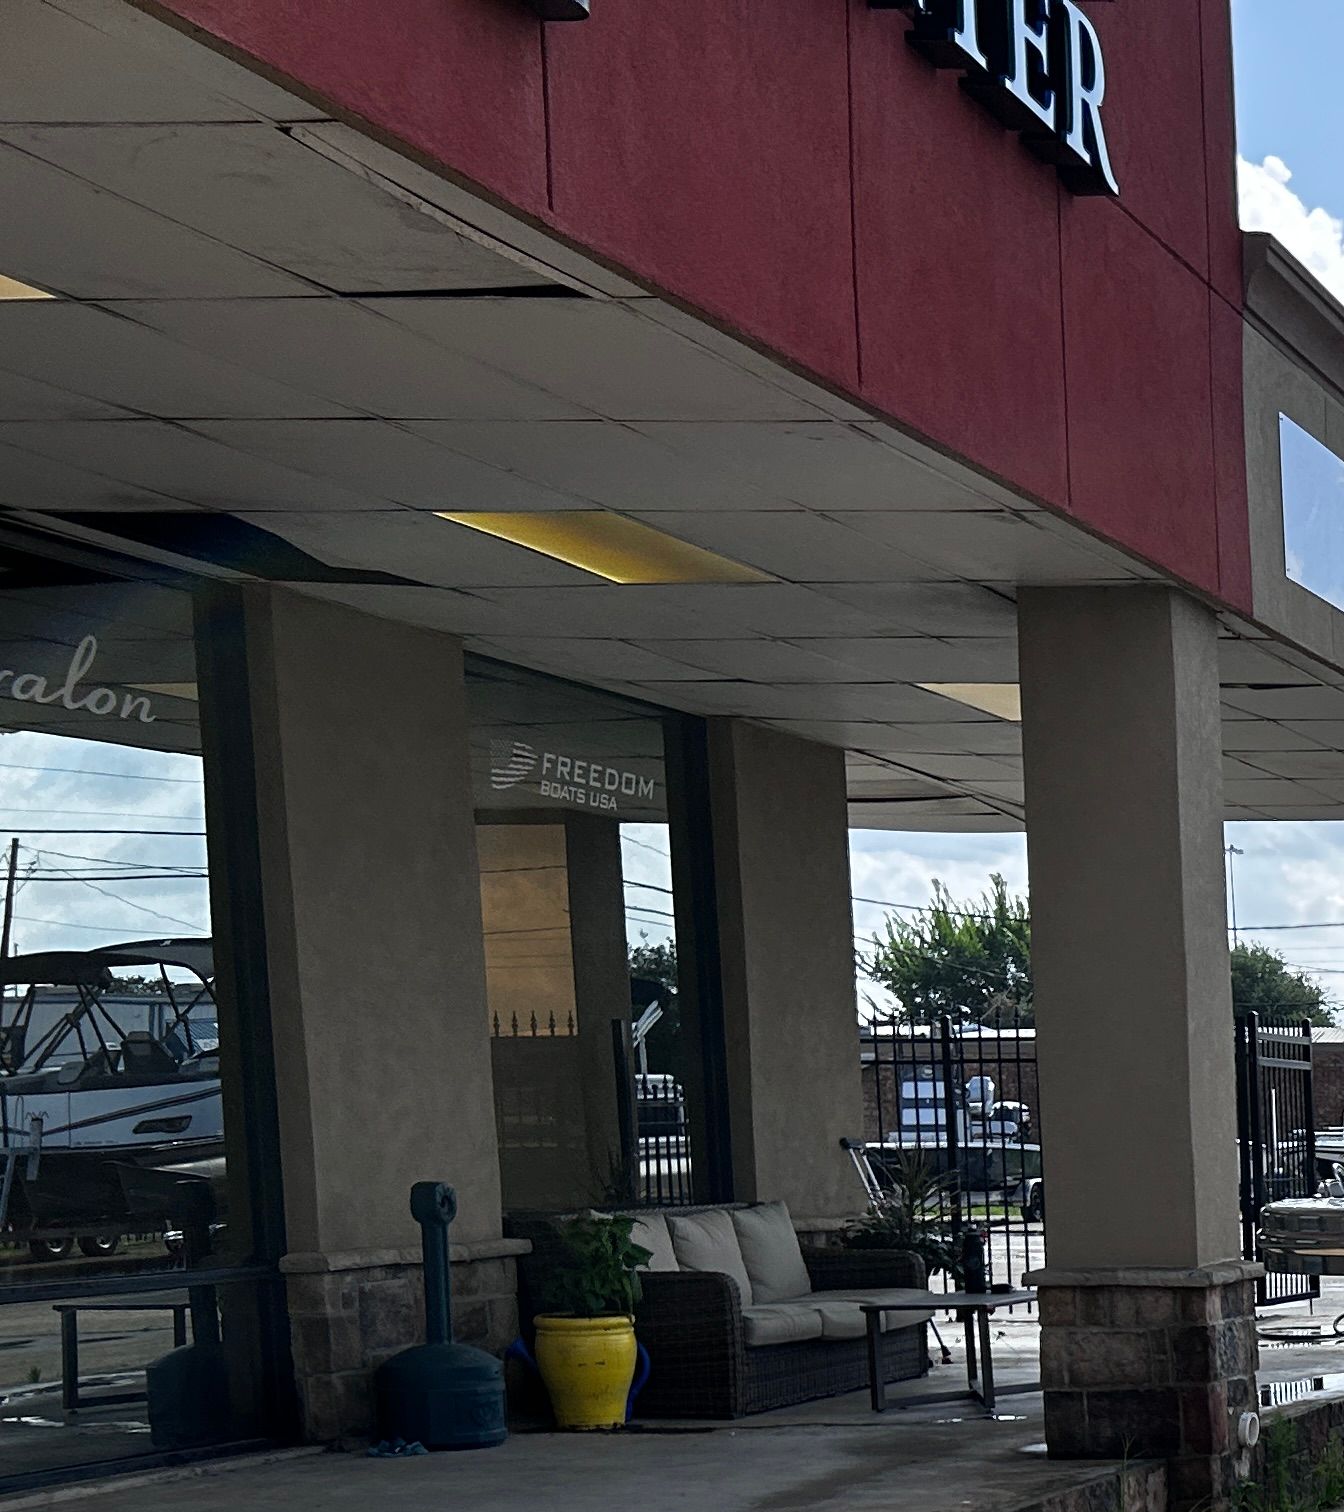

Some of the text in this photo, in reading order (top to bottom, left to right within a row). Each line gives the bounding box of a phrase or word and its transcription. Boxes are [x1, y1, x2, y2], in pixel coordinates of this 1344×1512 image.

[540, 780, 617, 811] BOATS USA
[542, 752, 654, 800] FREEDOM
